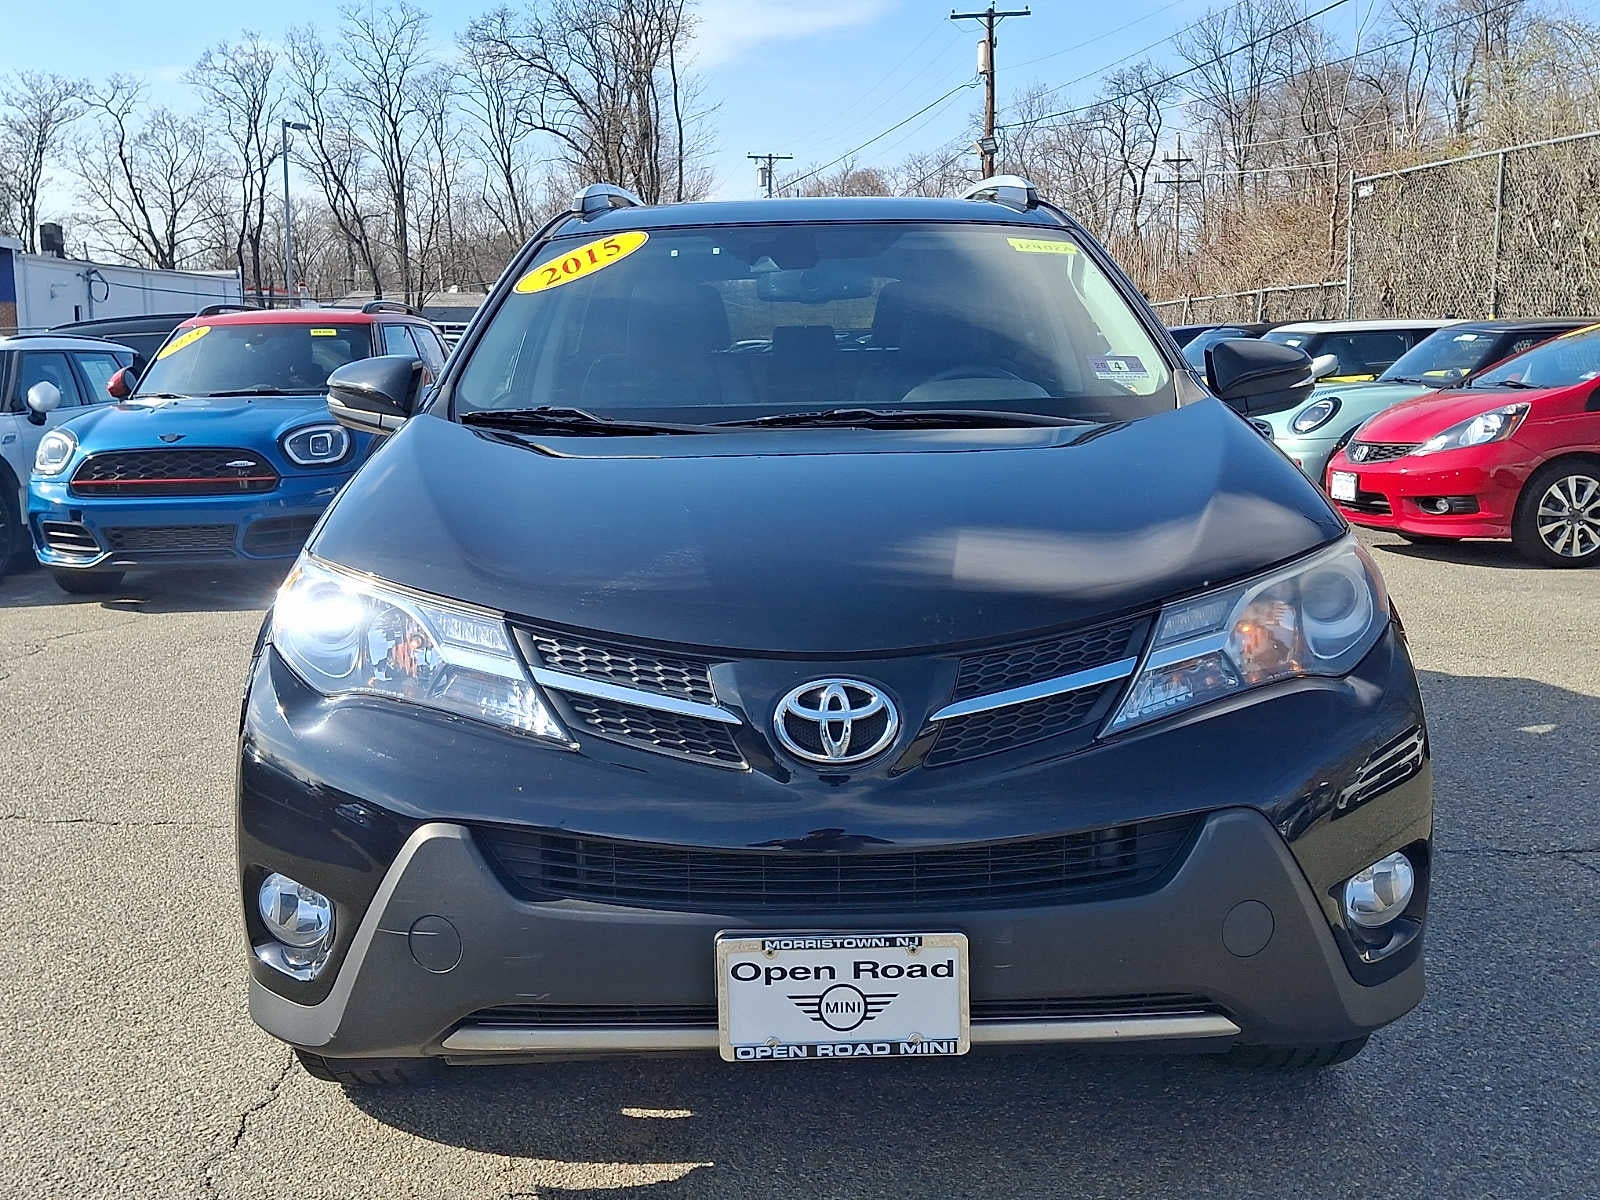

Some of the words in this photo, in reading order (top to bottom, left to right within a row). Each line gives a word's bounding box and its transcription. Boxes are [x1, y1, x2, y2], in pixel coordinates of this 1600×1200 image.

[541, 238, 621, 285] 2015
[1114, 361, 1122, 370] 4
[896, 937, 919, 947] NJ
[731, 962, 836, 985] Open
[853, 960, 954, 980] Road
[825, 1001, 861, 1014] MINI
[736, 1045, 807, 1059] OPEN
[817, 1043, 889, 1056] ROAD
[900, 1041, 955, 1054] MINI
